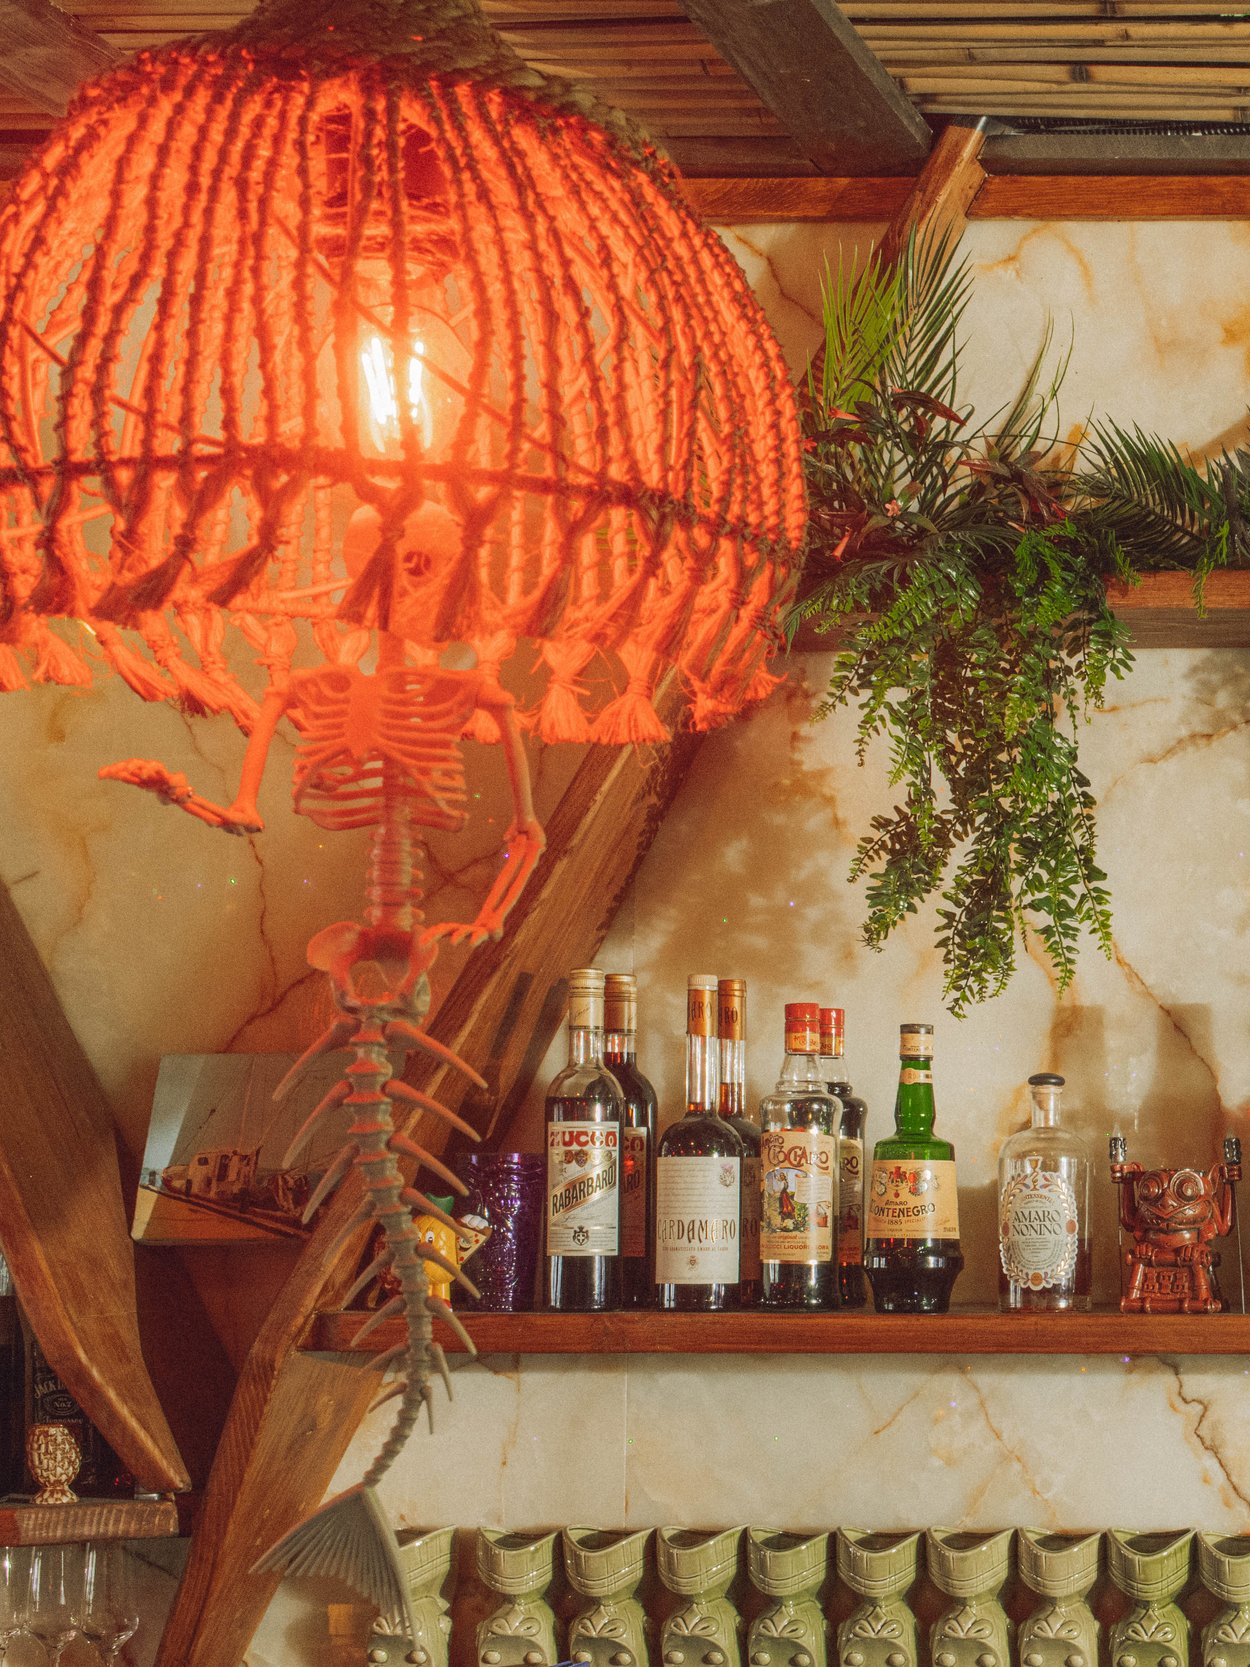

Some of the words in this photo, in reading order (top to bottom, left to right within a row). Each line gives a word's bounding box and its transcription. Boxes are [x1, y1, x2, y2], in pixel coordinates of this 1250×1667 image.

[552, 1164, 616, 1217] RABARBARO
[1012, 1209, 1061, 1224] AMARO
[1012, 1223, 1062, 1237] NONINO
